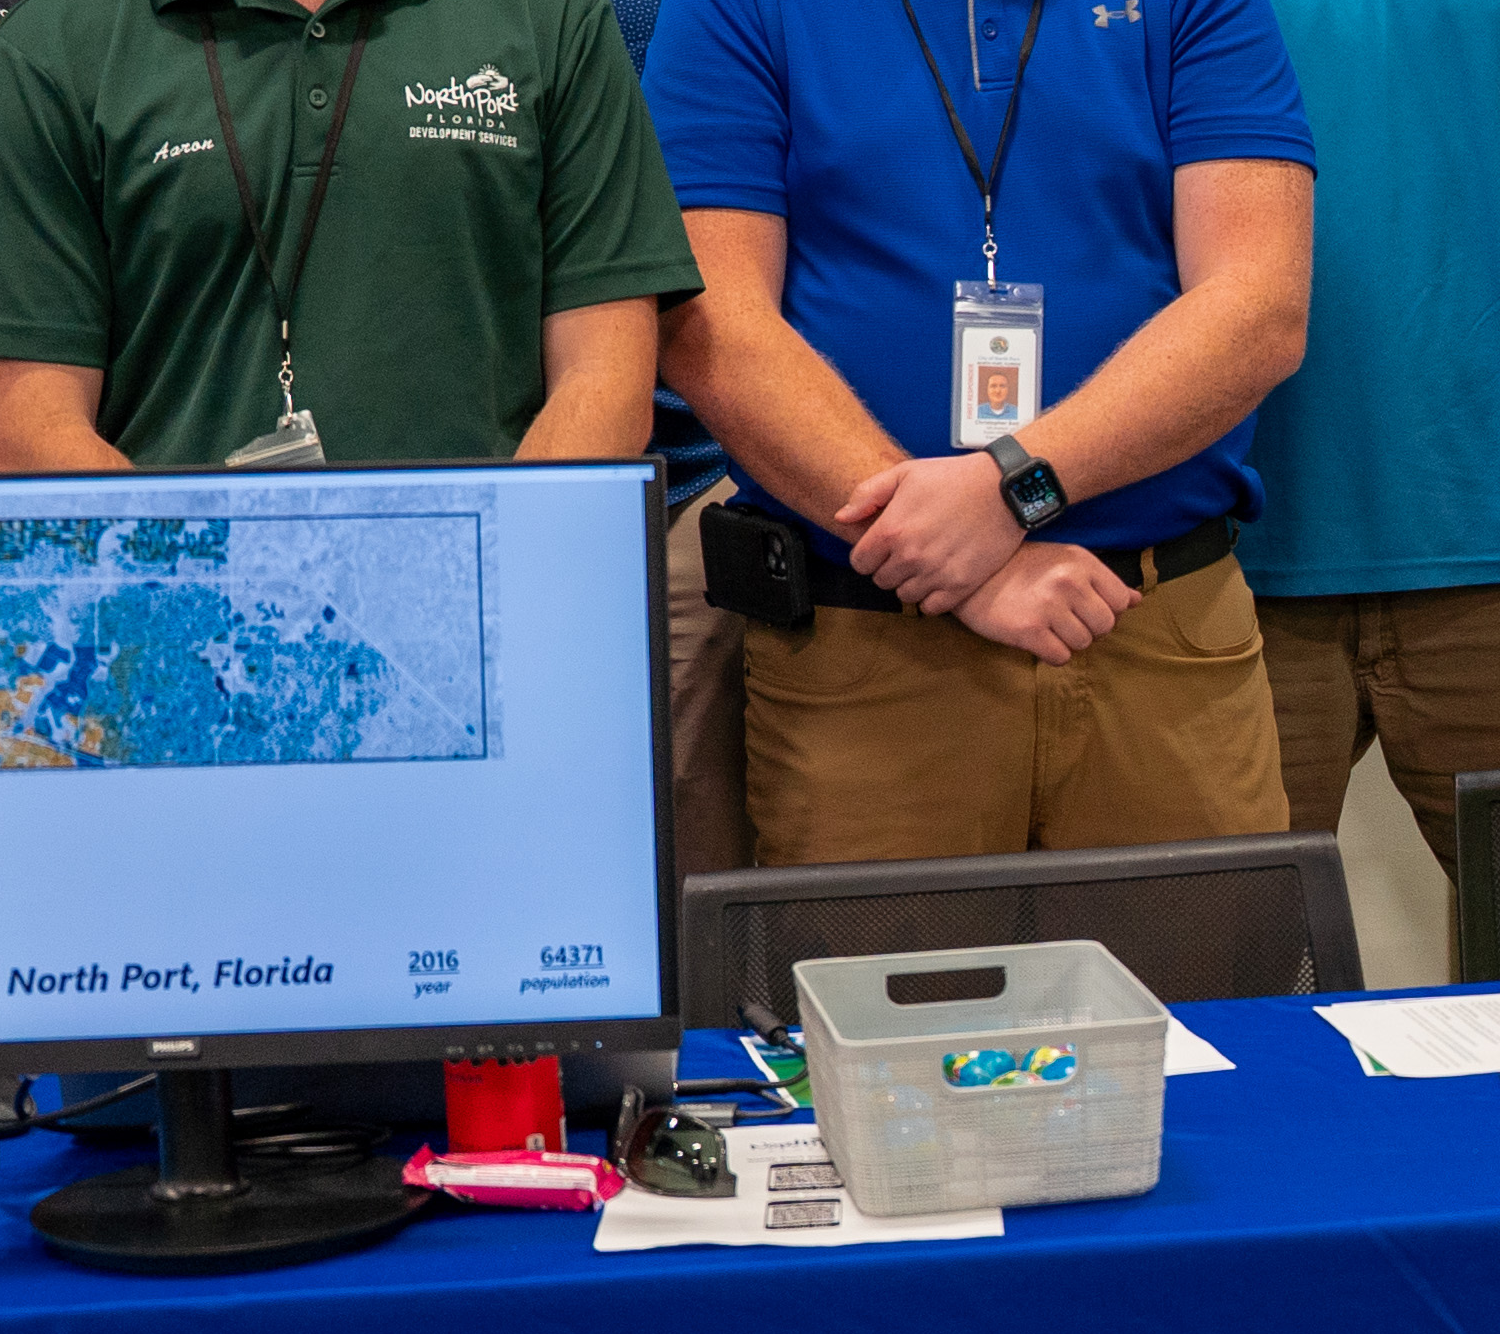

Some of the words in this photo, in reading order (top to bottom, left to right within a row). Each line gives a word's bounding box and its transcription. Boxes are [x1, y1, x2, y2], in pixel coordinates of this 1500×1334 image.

[426, 113, 506, 130] FLORIDA
[409, 125, 477, 142] DEVELOPMENT
[478, 130, 518, 148] SERVICES
[152, 137, 215, 164] Aaron
[408, 950, 459, 971] 2016
[540, 944, 604, 966] 64371
[7, 964, 108, 996] North
[120, 963, 200, 994] Port,
[213, 955, 334, 988] Florida
[519, 972, 610, 995] population
[414, 980, 453, 999] year
